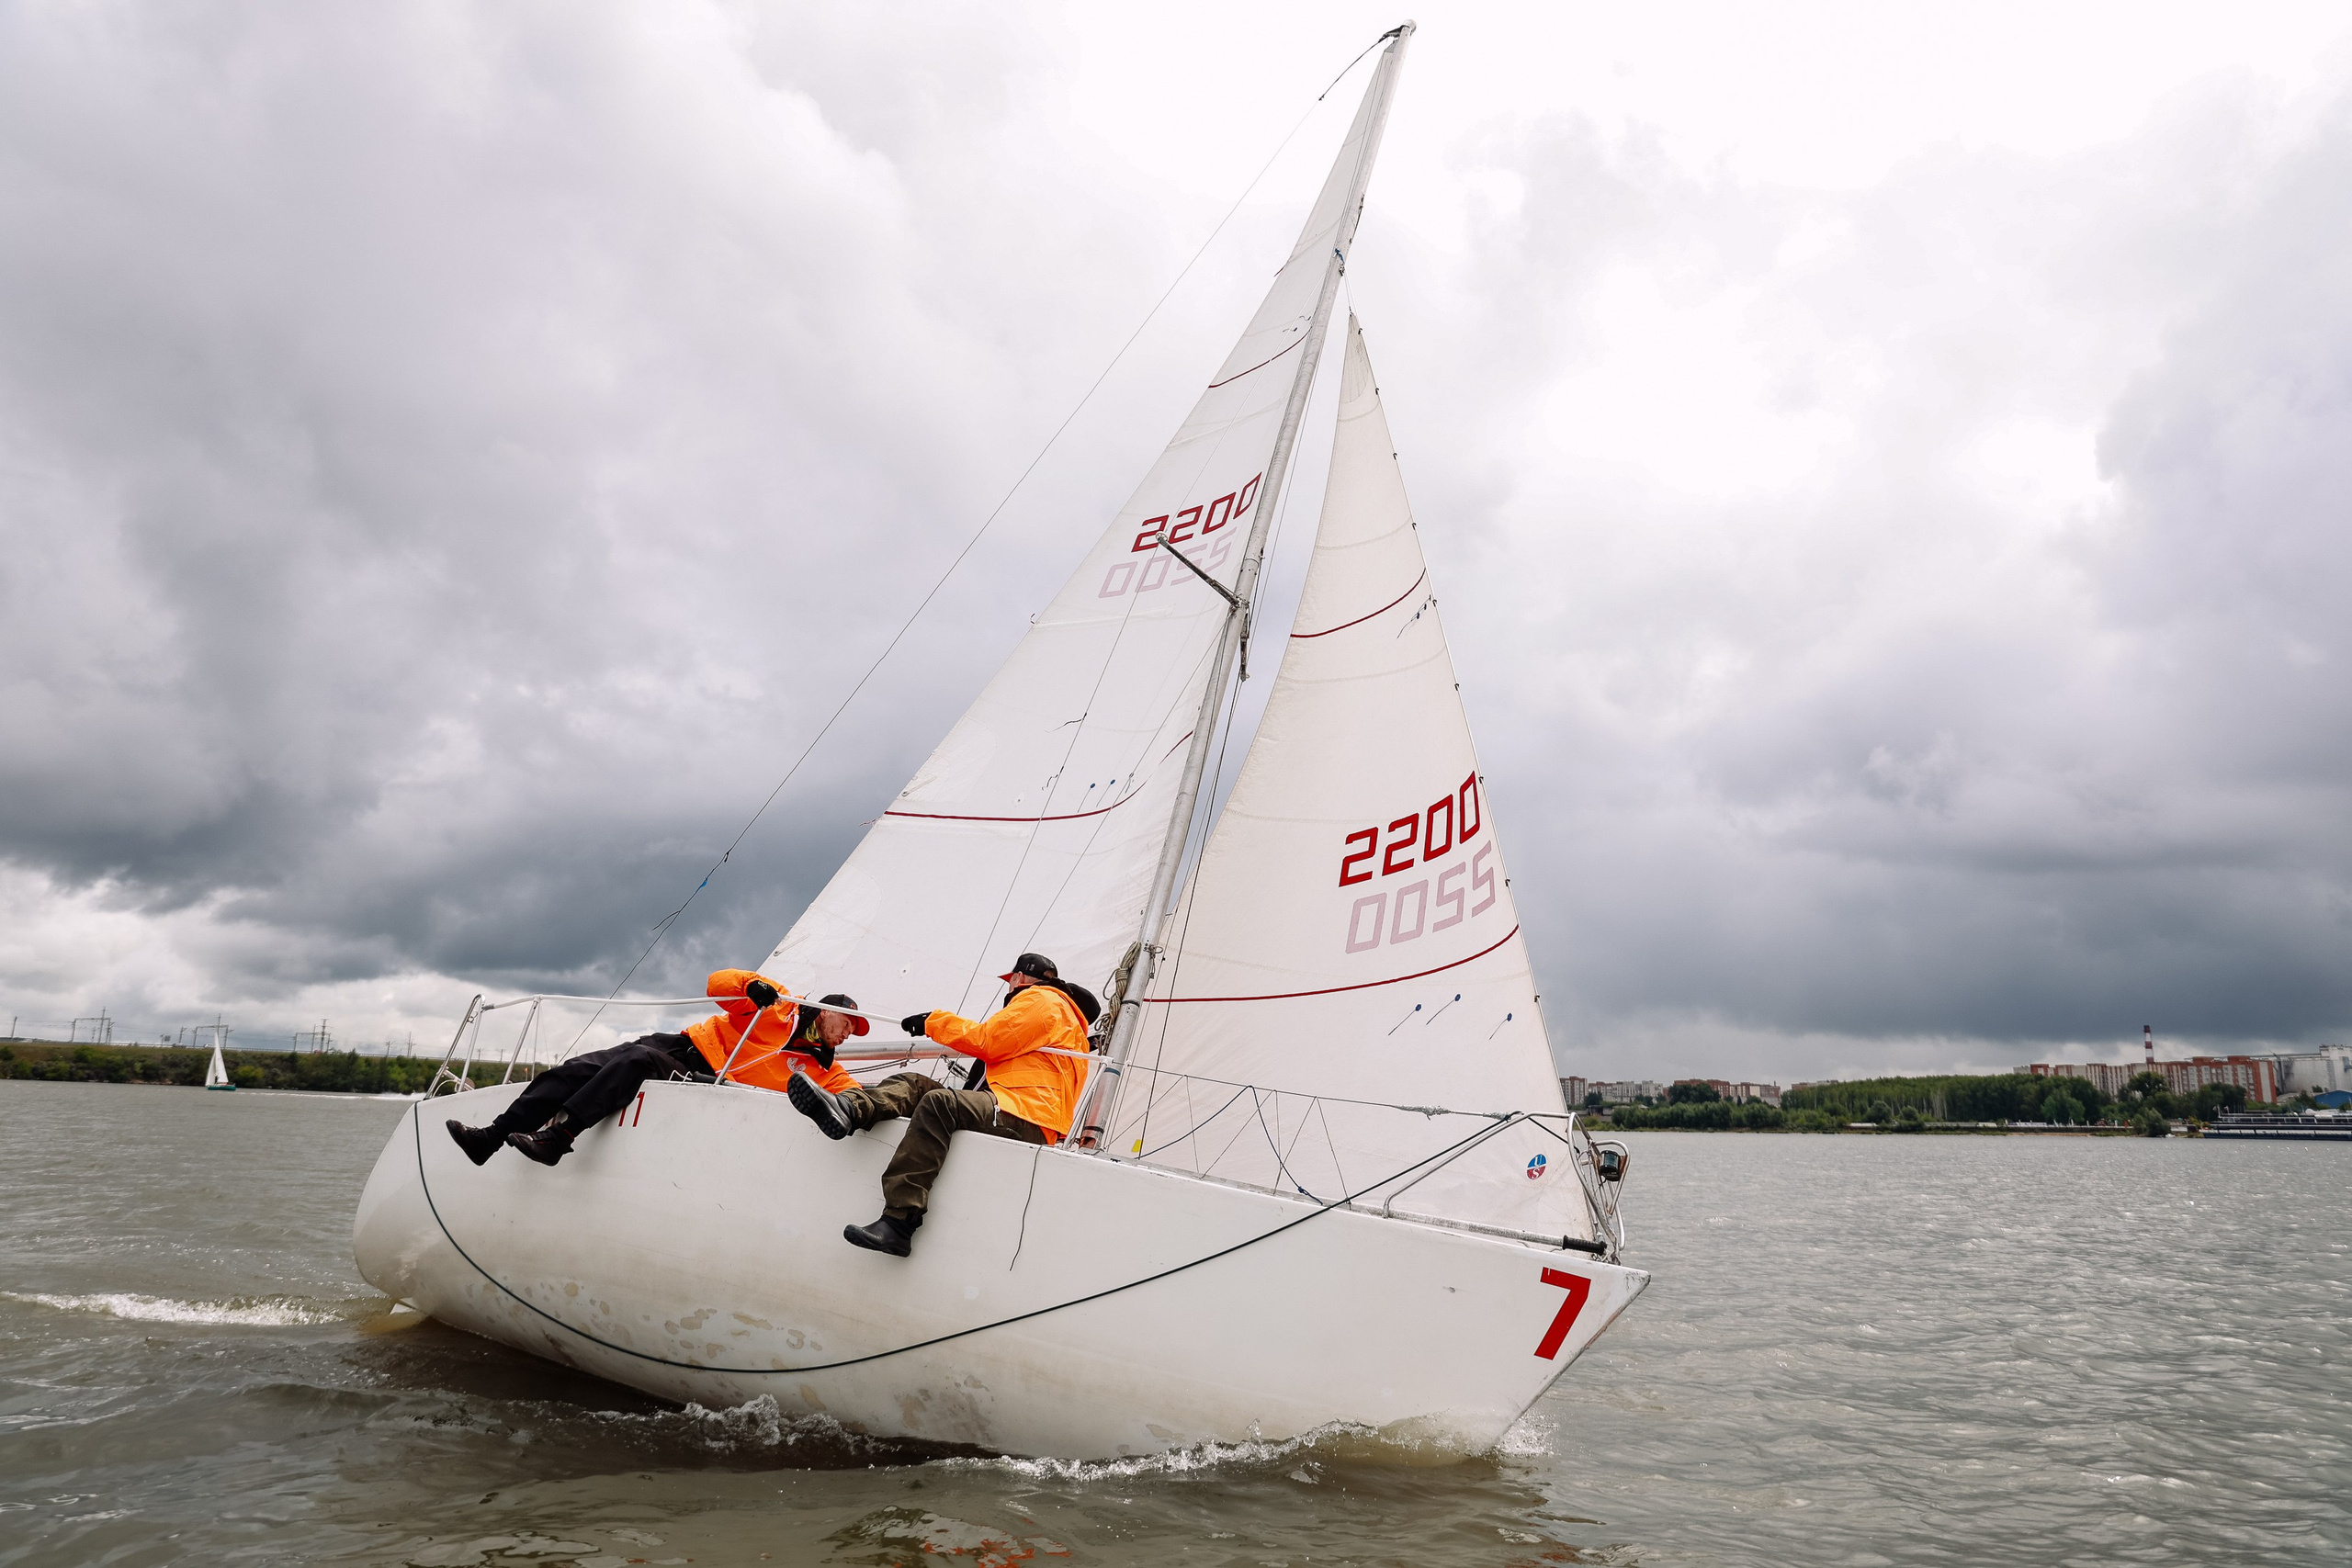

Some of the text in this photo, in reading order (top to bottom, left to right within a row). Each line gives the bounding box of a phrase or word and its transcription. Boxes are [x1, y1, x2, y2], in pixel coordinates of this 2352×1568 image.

[1131, 471, 1262, 553] 2200
[1339, 770, 1480, 887] 2200
[1533, 1267, 1591, 1360] 7
